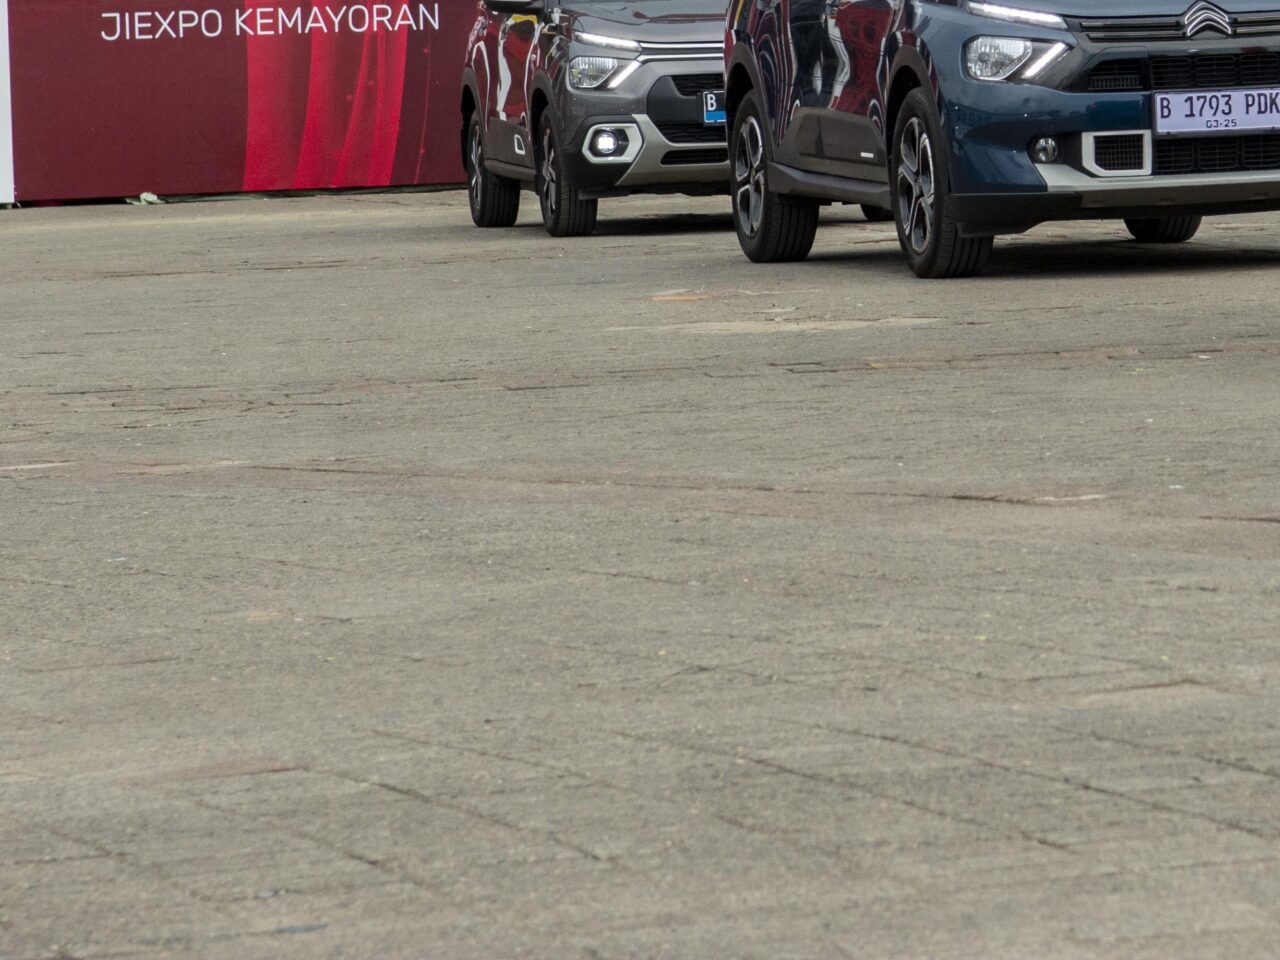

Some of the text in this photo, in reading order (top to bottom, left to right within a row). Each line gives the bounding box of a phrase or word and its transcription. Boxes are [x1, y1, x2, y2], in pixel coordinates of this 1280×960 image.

[101, 3, 440, 41] JIEXPO KEMAYORAN
[1160, 92, 1280, 119] B 1793 PDK
